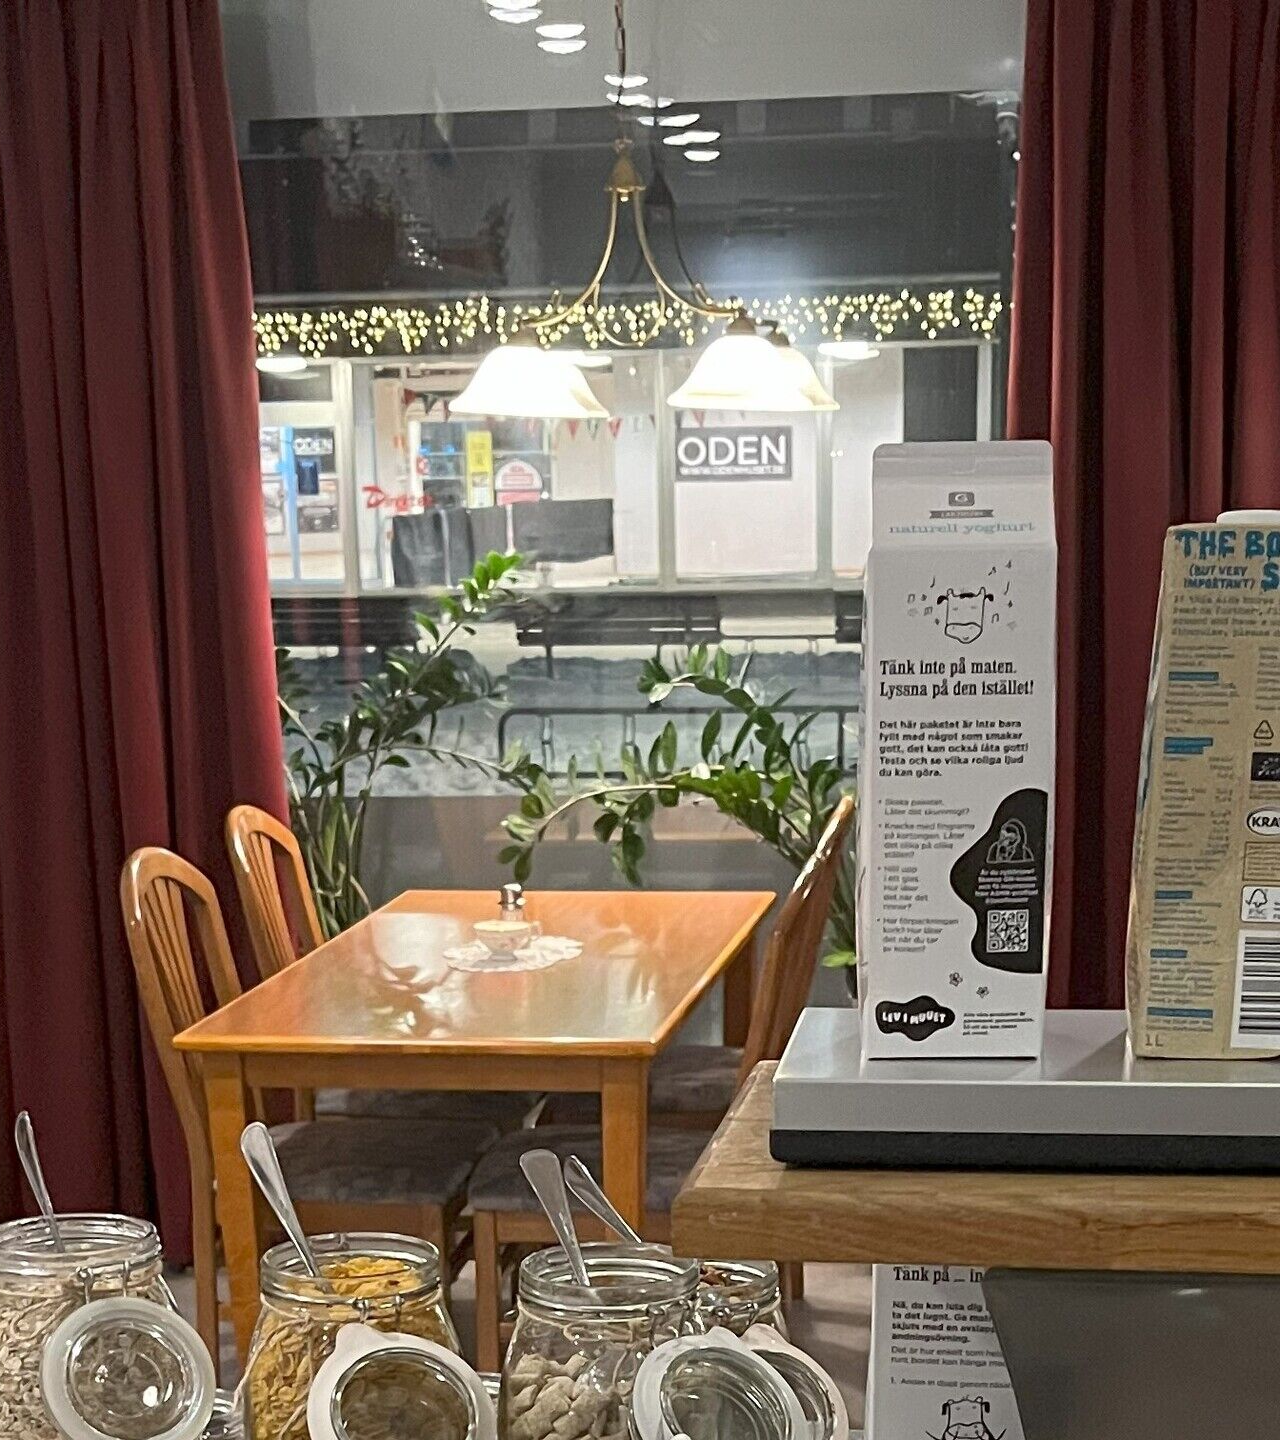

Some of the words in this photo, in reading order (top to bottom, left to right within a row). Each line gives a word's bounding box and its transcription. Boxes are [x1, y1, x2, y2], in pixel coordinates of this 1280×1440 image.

[677, 434, 787, 466] ODEN
[1175, 529, 1237, 560] THE
[1189, 563, 1215, 576] (BUT
[1219, 565, 1249, 576] VERY
[1184, 578, 1255, 590] IMPORTANT)
[879, 659, 915, 675] Tänk
[920, 660, 946, 675] inte
[949, 657, 966, 677] på
[971, 661, 1017, 674] maten.
[879, 681, 928, 699] Lyssna
[932, 678, 949, 699] på
[953, 681, 977, 696] den
[982, 680, 1034, 696] istället!
